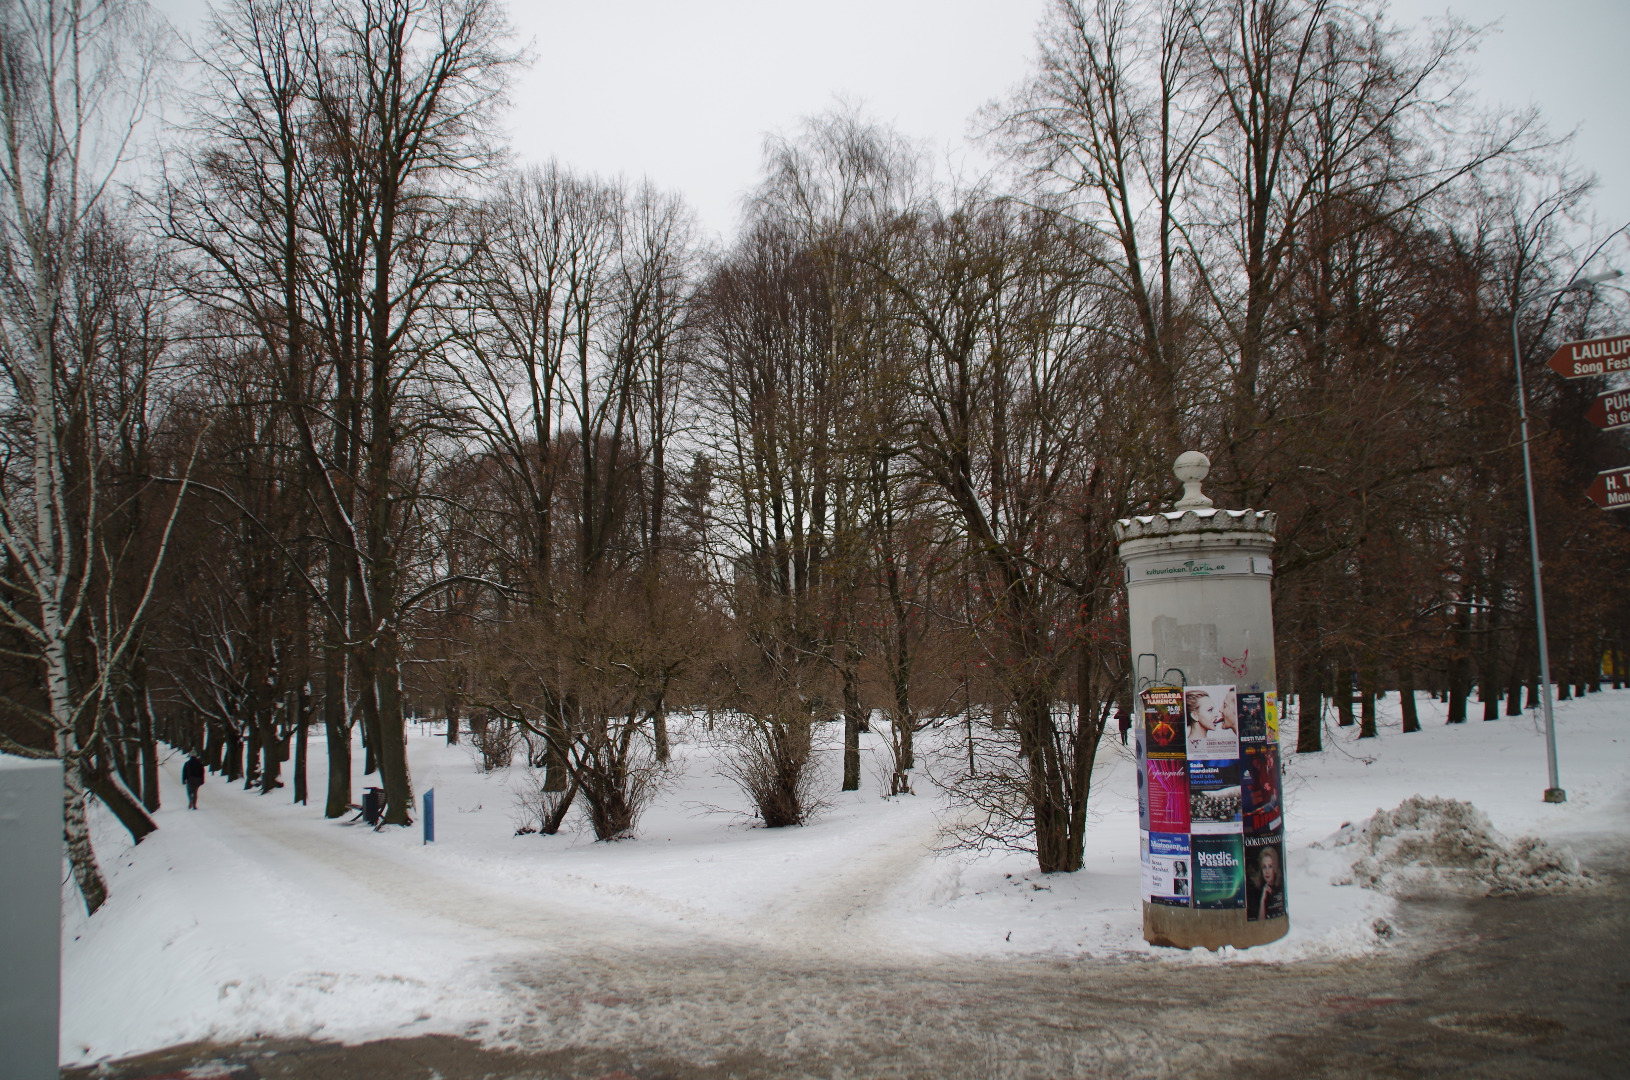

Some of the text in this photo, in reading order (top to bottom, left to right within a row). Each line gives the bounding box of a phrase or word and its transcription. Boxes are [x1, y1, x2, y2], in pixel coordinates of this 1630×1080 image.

[1572, 339, 1630, 360] LAULUP
[1574, 362, 1604, 374] Song
[1606, 413, 1619, 426] St
[1605, 475, 1621, 491] H.
[1197, 851, 1232, 861] Nordic
[1200, 858, 1239, 867] Passion
